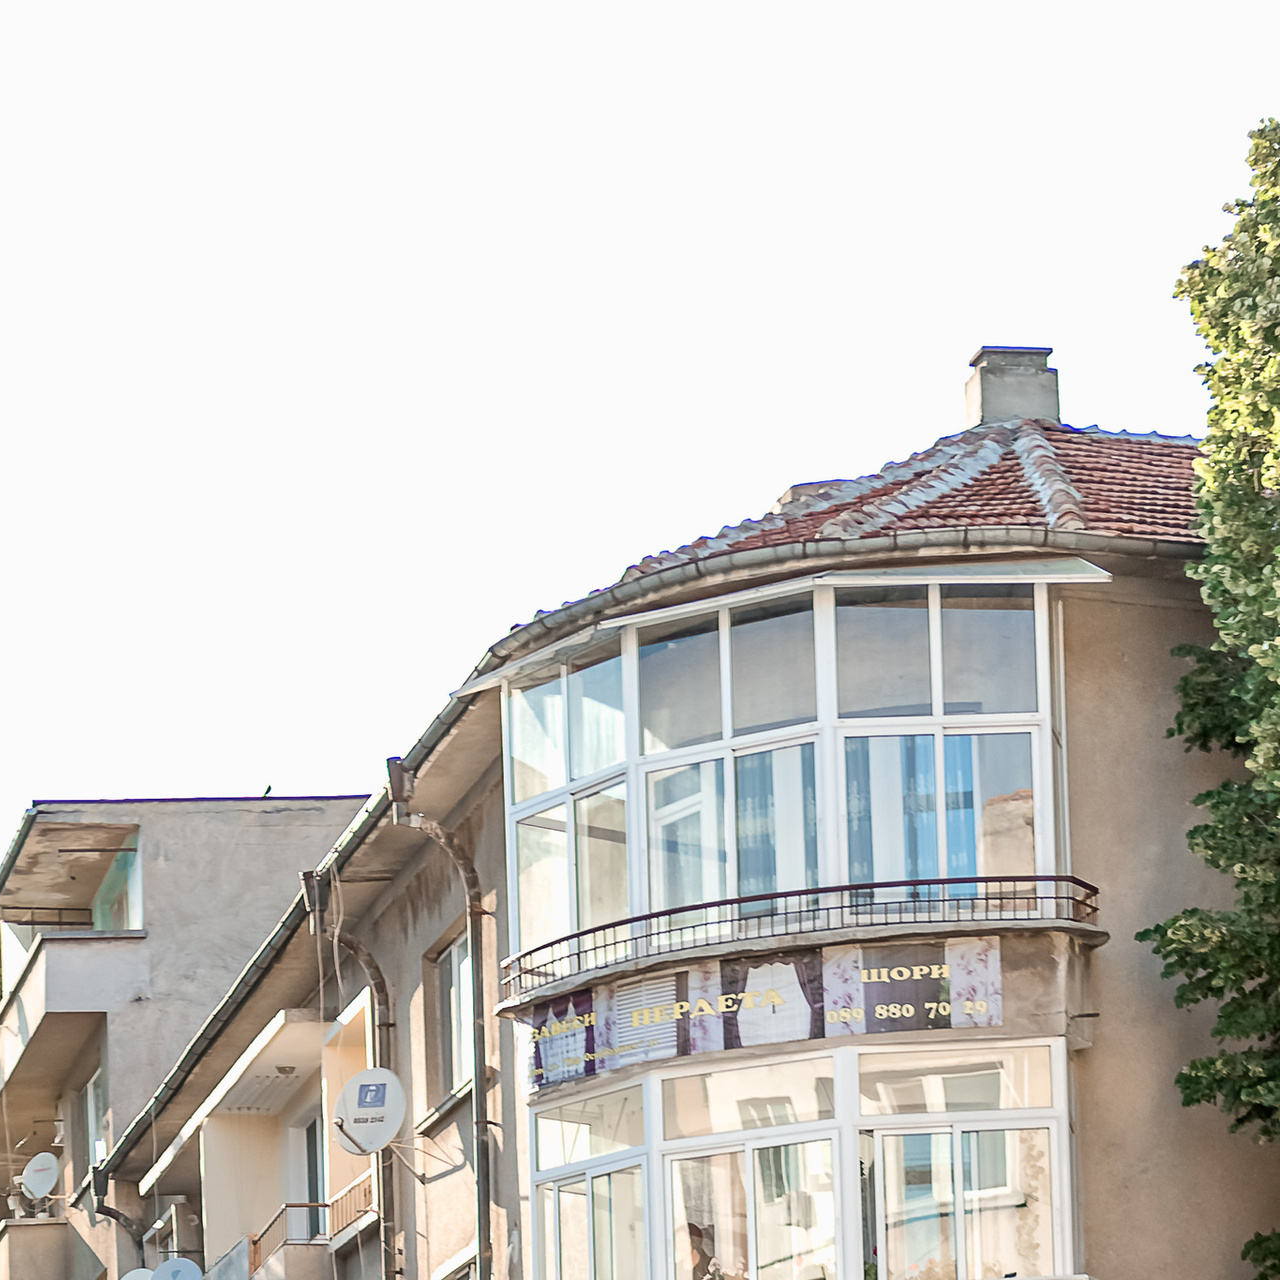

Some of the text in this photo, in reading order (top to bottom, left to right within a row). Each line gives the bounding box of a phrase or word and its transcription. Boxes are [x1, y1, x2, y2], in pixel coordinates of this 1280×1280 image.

[860, 964, 951, 983] ЩОРИ
[825, 1007, 865, 1023] 089
[874, 1003, 915, 1019] 880
[924, 1001, 952, 1019] 70
